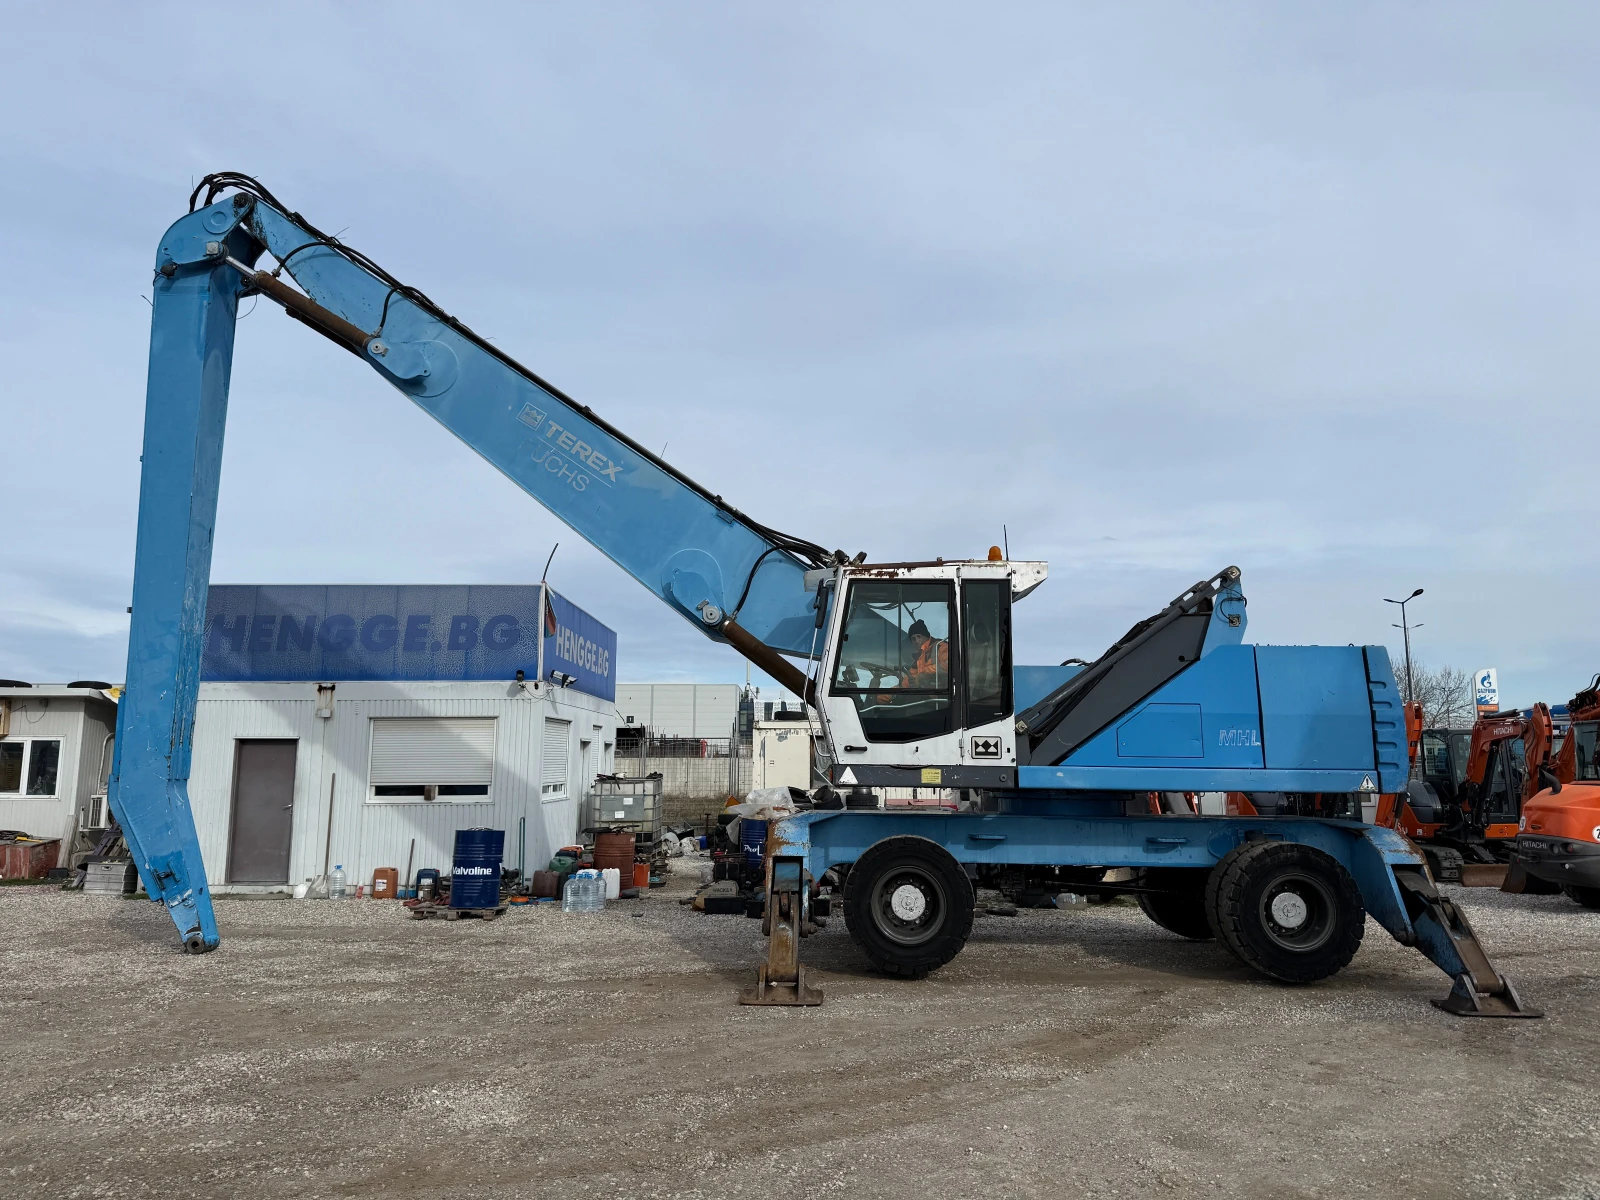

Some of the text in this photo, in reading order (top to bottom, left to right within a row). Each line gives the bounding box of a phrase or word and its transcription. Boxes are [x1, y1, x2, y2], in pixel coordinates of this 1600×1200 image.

[546, 420, 624, 483] TEREX
[207, 613, 521, 653] HENGGE.BG
[555, 623, 609, 678] HENGGE.BG
[1218, 729, 1261, 746] MHL
[1493, 726, 1514, 736] HITACHI
[1522, 840, 1548, 850] HITACHI
[452, 866, 493, 876] Valvoline
